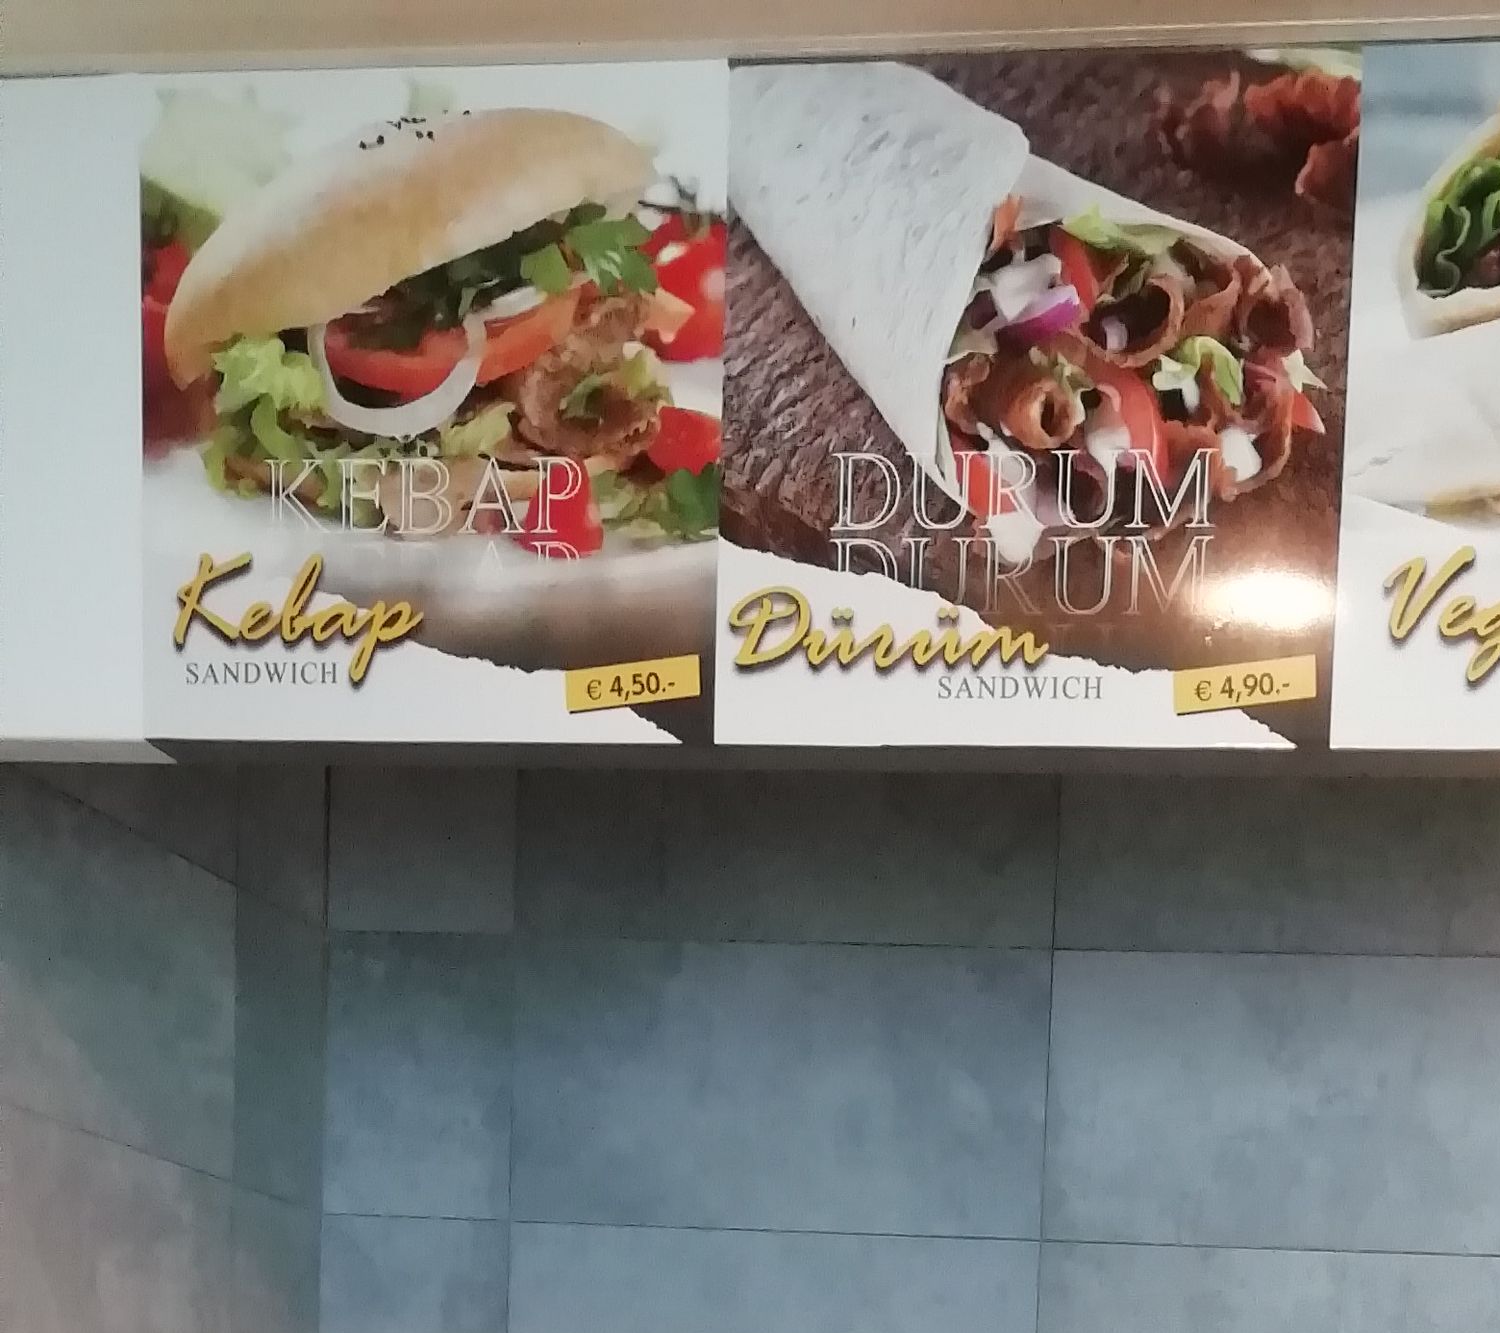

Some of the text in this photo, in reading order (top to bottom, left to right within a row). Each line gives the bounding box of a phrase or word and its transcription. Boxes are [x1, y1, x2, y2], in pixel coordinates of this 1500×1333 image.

[264, 456, 584, 535] KEBAP
[173, 551, 425, 684] Kebap
[729, 586, 1049, 670] Dürüm
[185, 661, 338, 686] SANDWICH
[586, 672, 677, 702] € 4,50.-
[937, 675, 1103, 700] SANDWICH
[1194, 673, 1291, 702] € 4,90.-
